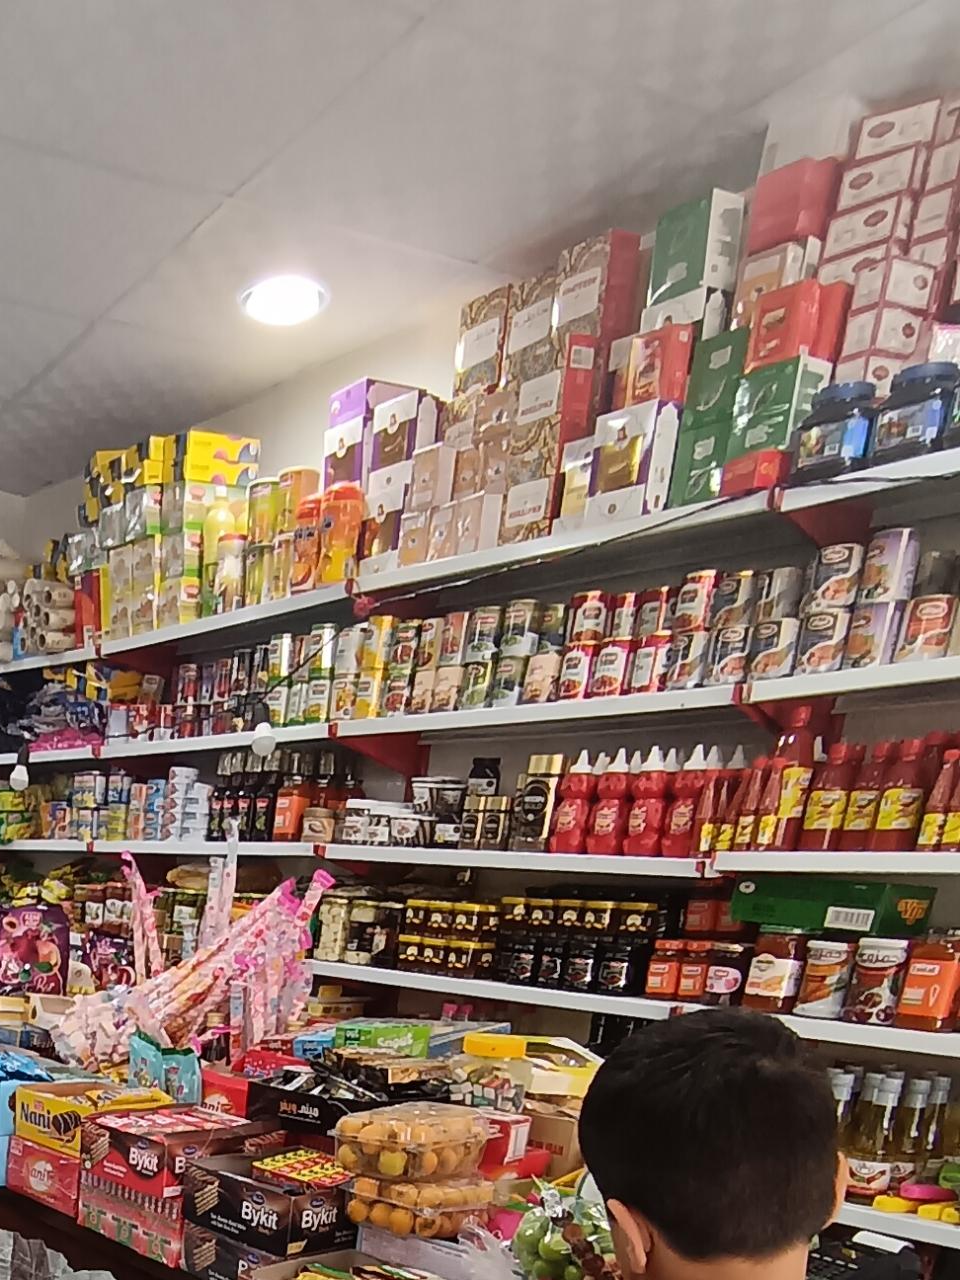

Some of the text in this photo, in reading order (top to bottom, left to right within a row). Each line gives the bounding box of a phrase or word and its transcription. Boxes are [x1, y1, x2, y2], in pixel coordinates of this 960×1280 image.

[20, 1101, 51, 1130] Nani
[129, 1147, 159, 1173] Bykit
[241, 1200, 279, 1230] Bykit
[301, 1207, 338, 1230] Bykit
